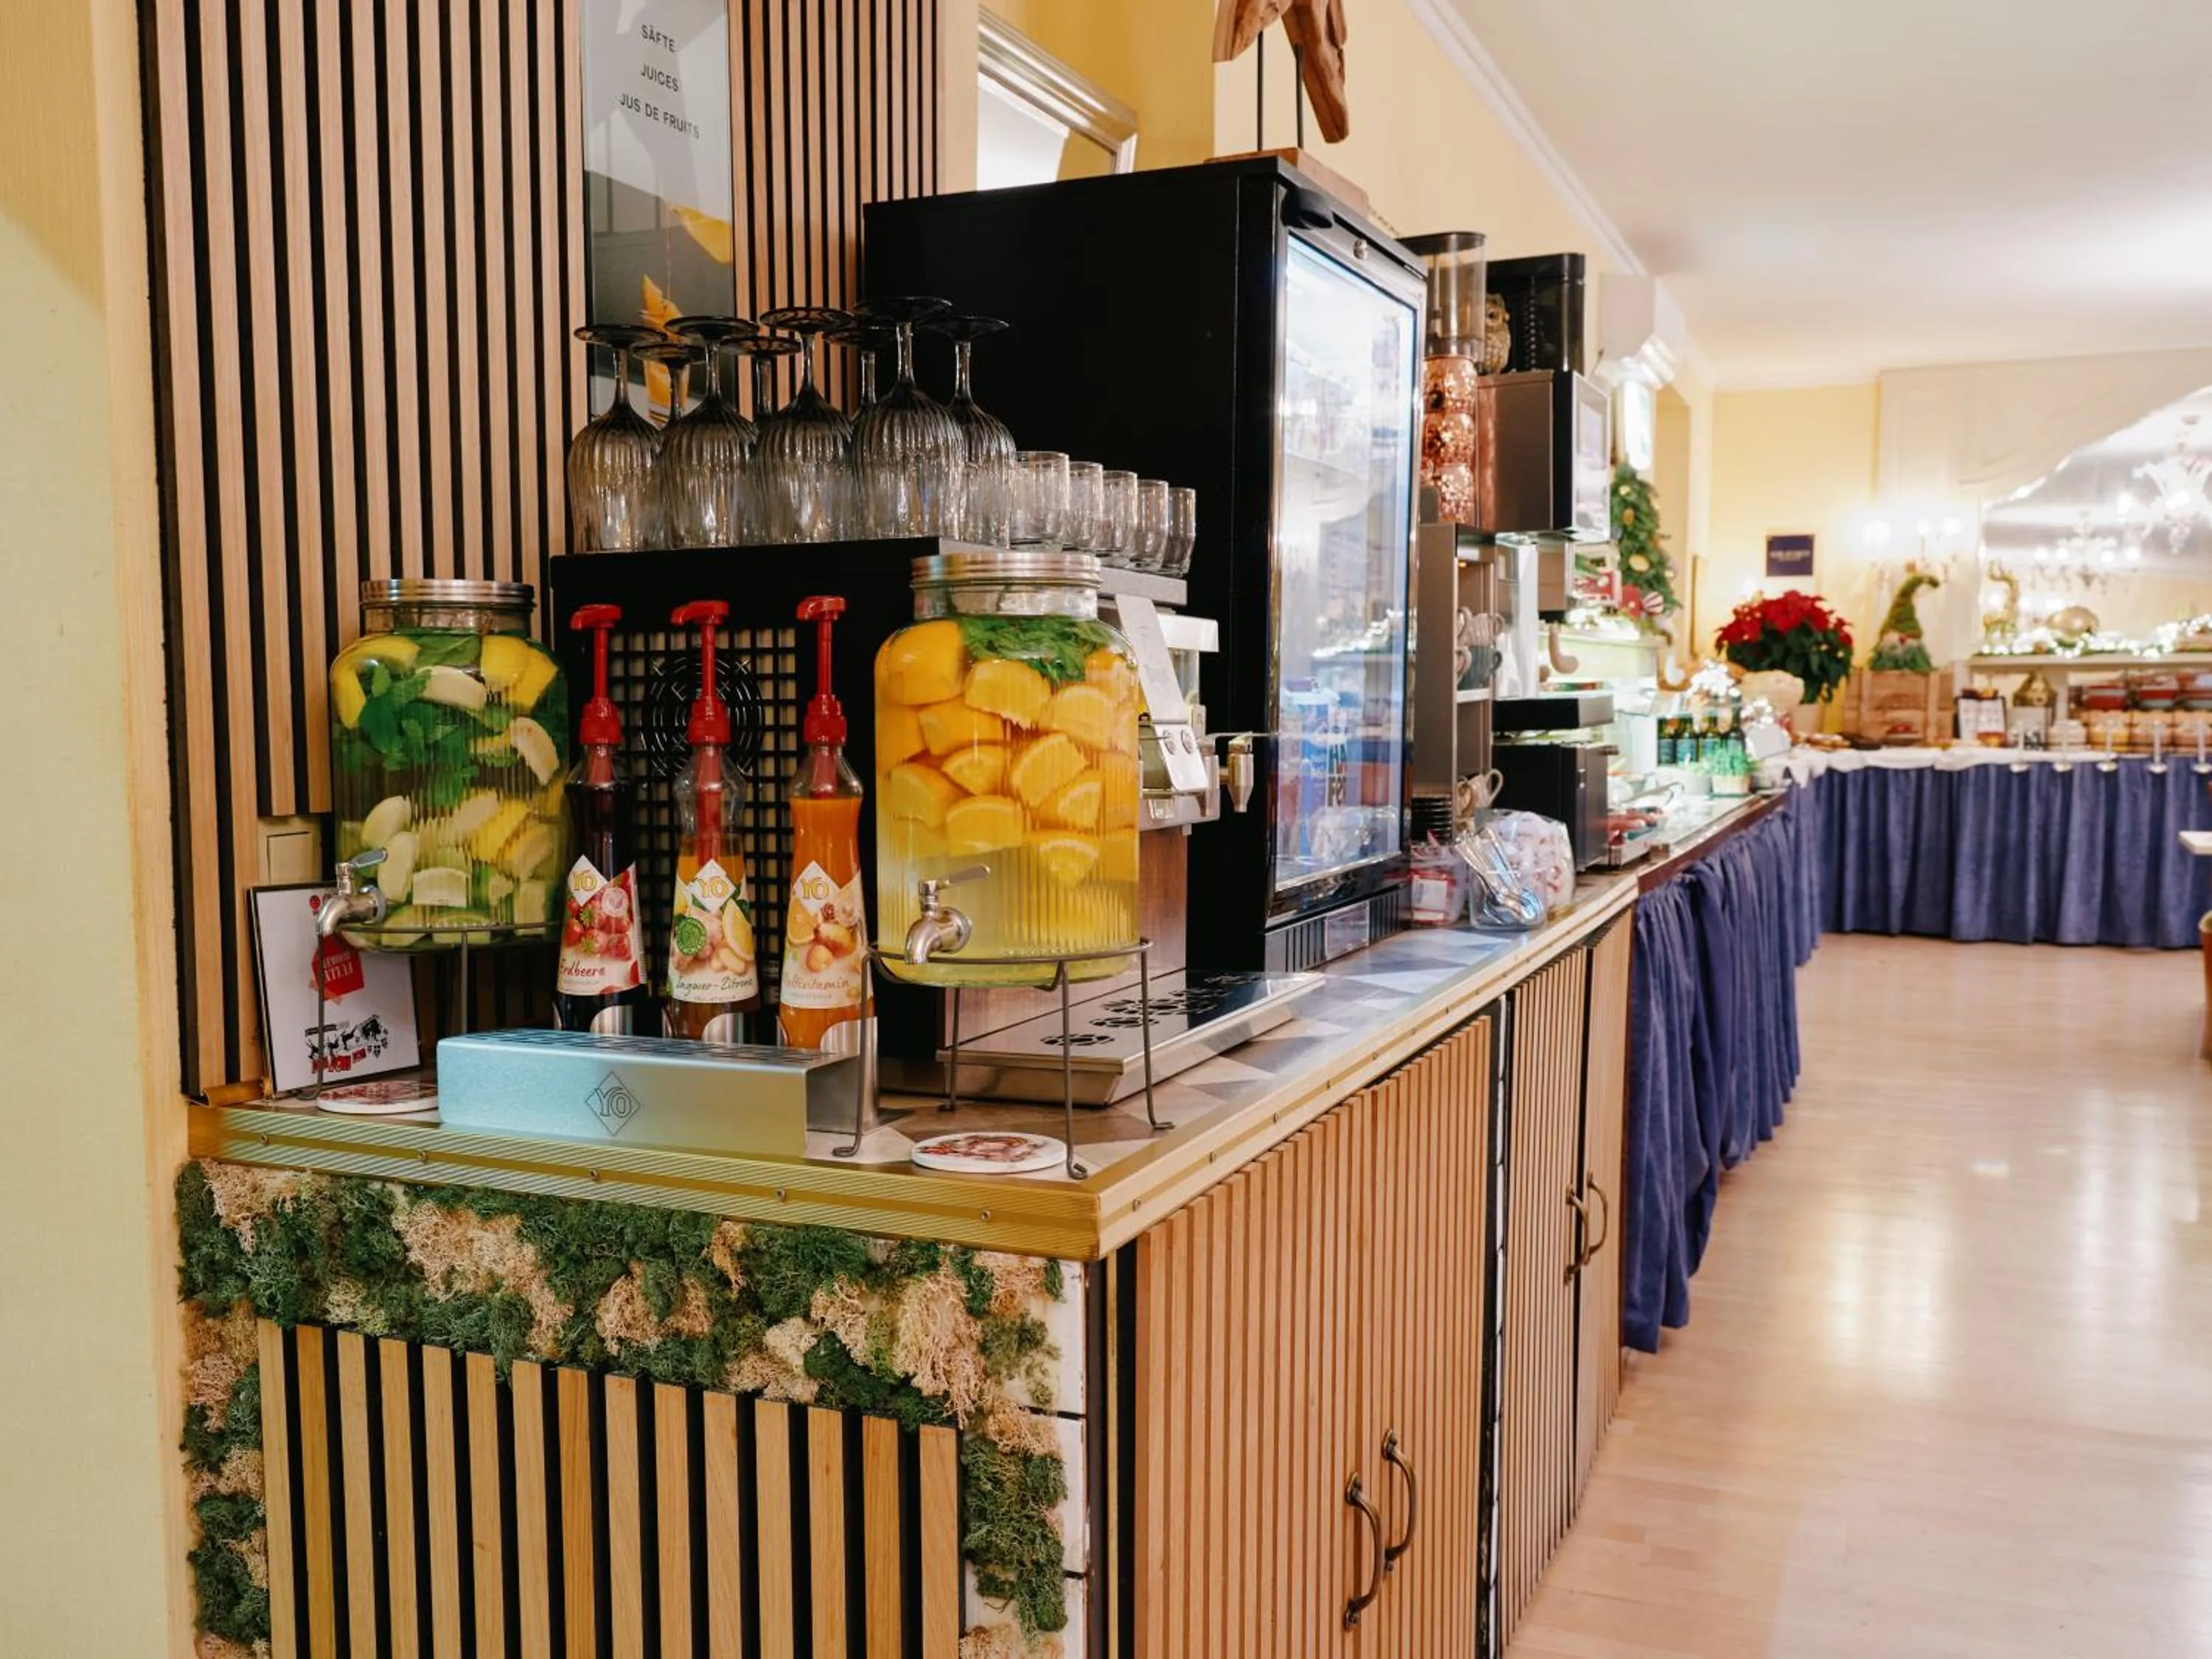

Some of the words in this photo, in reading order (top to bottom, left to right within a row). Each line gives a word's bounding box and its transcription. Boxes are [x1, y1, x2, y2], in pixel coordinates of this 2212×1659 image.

[641, 24, 675, 52] SÄFTE
[641, 64, 679, 91] JUICES
[620, 93, 641, 113] JUS
[645, 103, 659, 121] DE
[663, 111, 700, 139] FRUITS
[594, 1086, 633, 1118] YO
